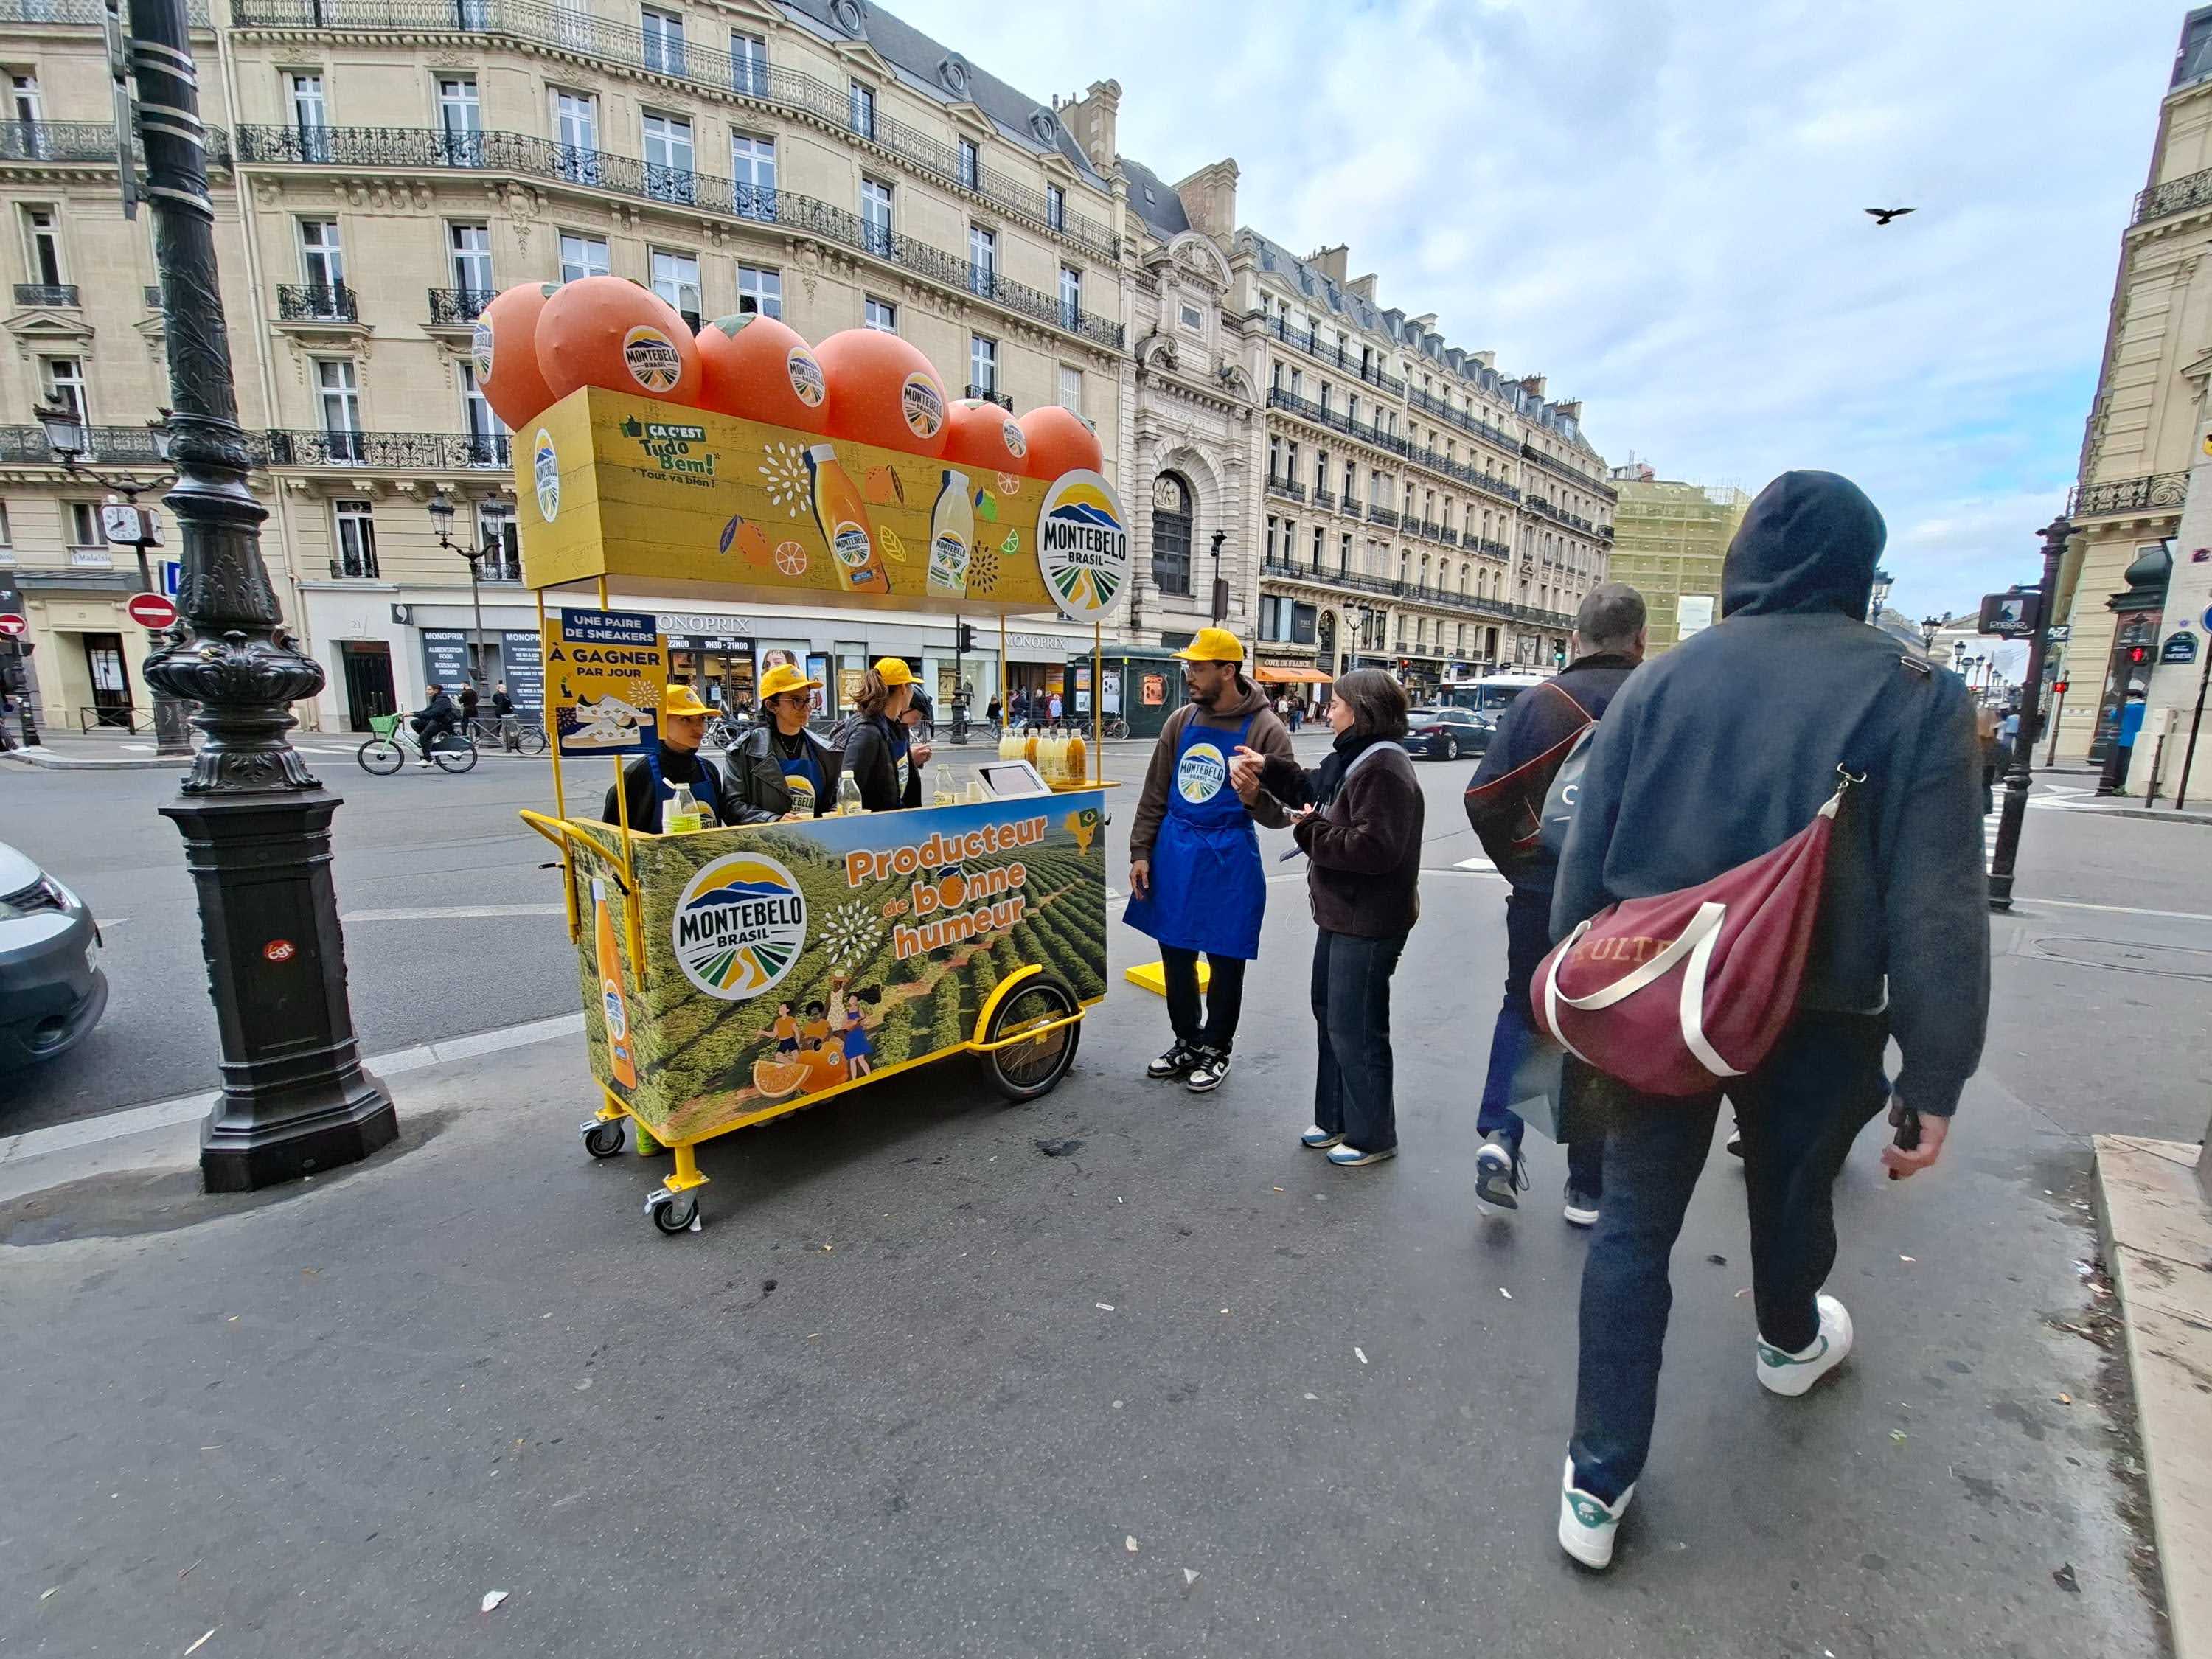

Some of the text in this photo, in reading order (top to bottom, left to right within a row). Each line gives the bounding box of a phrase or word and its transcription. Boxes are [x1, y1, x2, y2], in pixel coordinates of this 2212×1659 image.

[626, 349, 678, 364] MONTEBELO
[904, 387, 943, 418] MONTEBELO
[649, 425, 703, 438] ÇA C'EST
[639, 438, 689, 456] Tudo
[640, 469, 668, 481] Tout
[669, 476, 683, 484] va
[686, 476, 709, 487] bien
[835, 534, 868, 550] MONTEBELO
[936, 540, 966, 557] MONTEBELO
[1044, 521, 1126, 561] MONTEBELO
[1068, 552, 1103, 566] BRASIL
[574, 616, 641, 628] UNE PAIRE
[658, 615, 751, 633] ONOPRIX
[566, 628, 654, 642] DE SNEAKERS
[1005, 636, 1066, 650] MONOPRIX
[668, 640, 689, 648] 22H00
[704, 641, 722, 649] 9H30
[549, 642, 661, 666] À GAGNER
[577, 667, 641, 678] PAR JOUR
[1180, 762, 1224, 781] MONTEBELO
[793, 796, 814, 808] EBELO
[846, 815, 1048, 887] Producteur
[883, 898, 909, 918] de
[680, 897, 802, 947] MONTEBELO
[894, 896, 1026, 960] humeur
[717, 929, 770, 948] BRASIL
